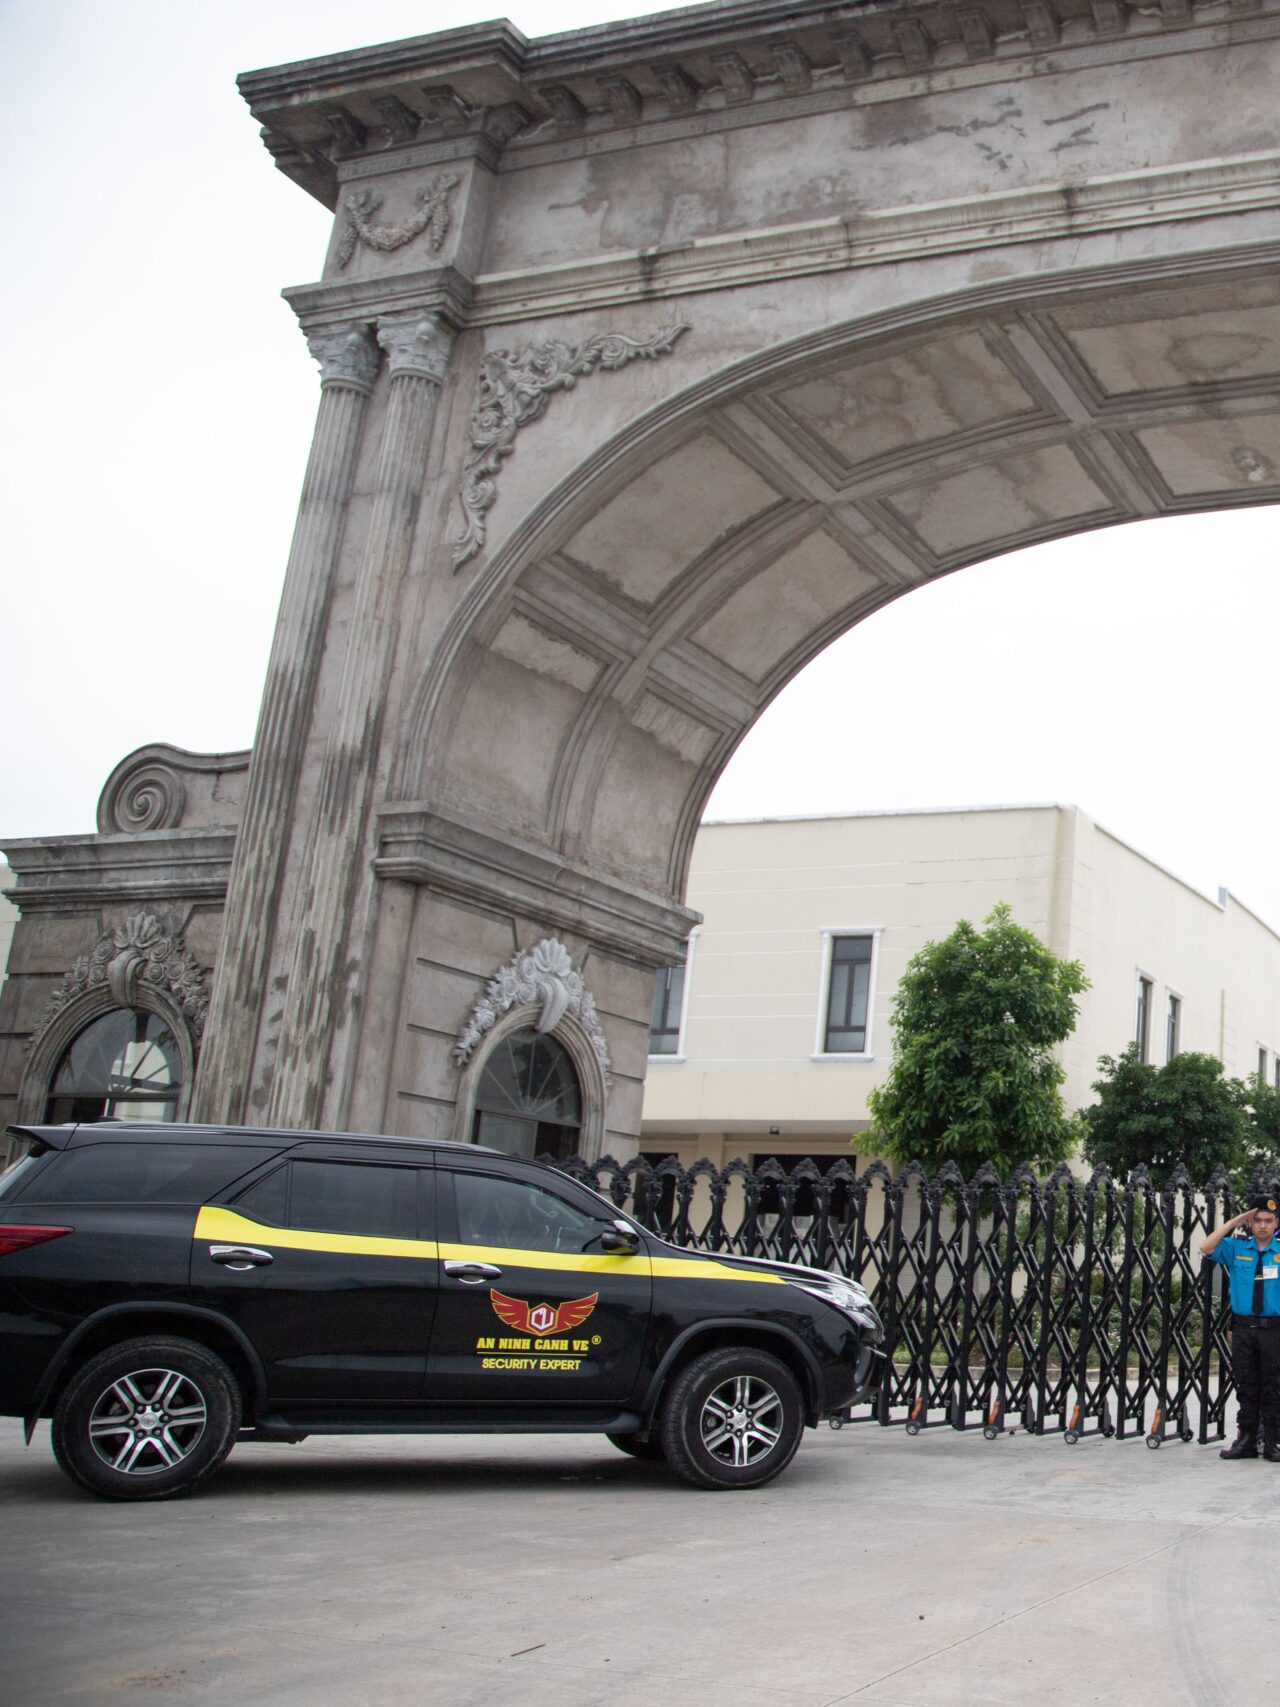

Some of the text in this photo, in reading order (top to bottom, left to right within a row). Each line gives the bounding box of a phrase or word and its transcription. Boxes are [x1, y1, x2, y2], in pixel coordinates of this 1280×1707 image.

[476, 1338, 589, 1351] AN NINH CANH VE
[482, 1358, 581, 1370] SECURITY EXPERT
